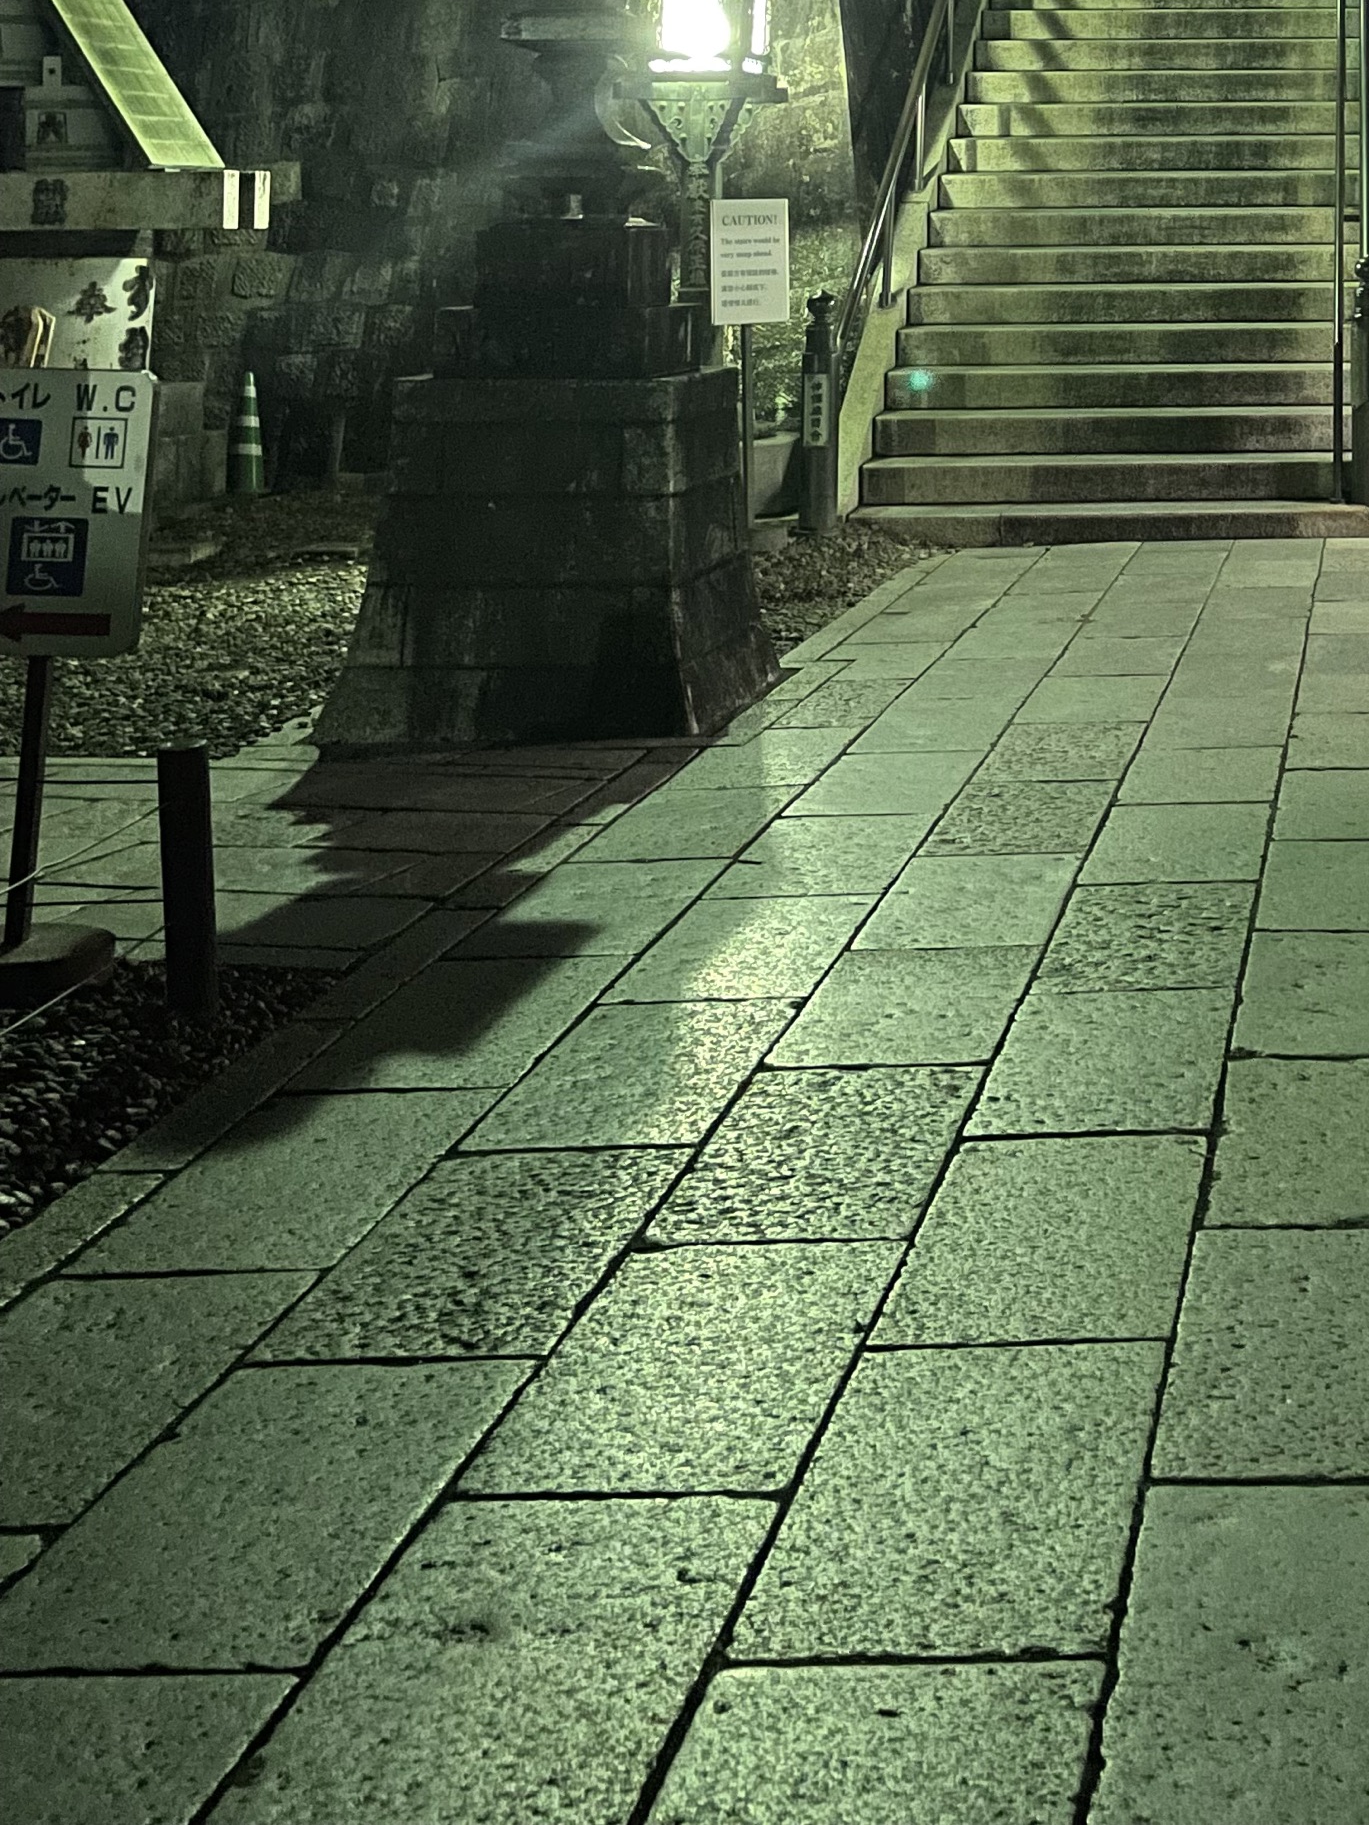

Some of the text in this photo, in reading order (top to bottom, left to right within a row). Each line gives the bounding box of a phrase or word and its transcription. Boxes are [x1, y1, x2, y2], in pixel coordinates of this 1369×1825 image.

[722, 214, 778, 227] CAUTION!
[76, 383, 136, 413] W.C
[91, 486, 133, 515] EV
